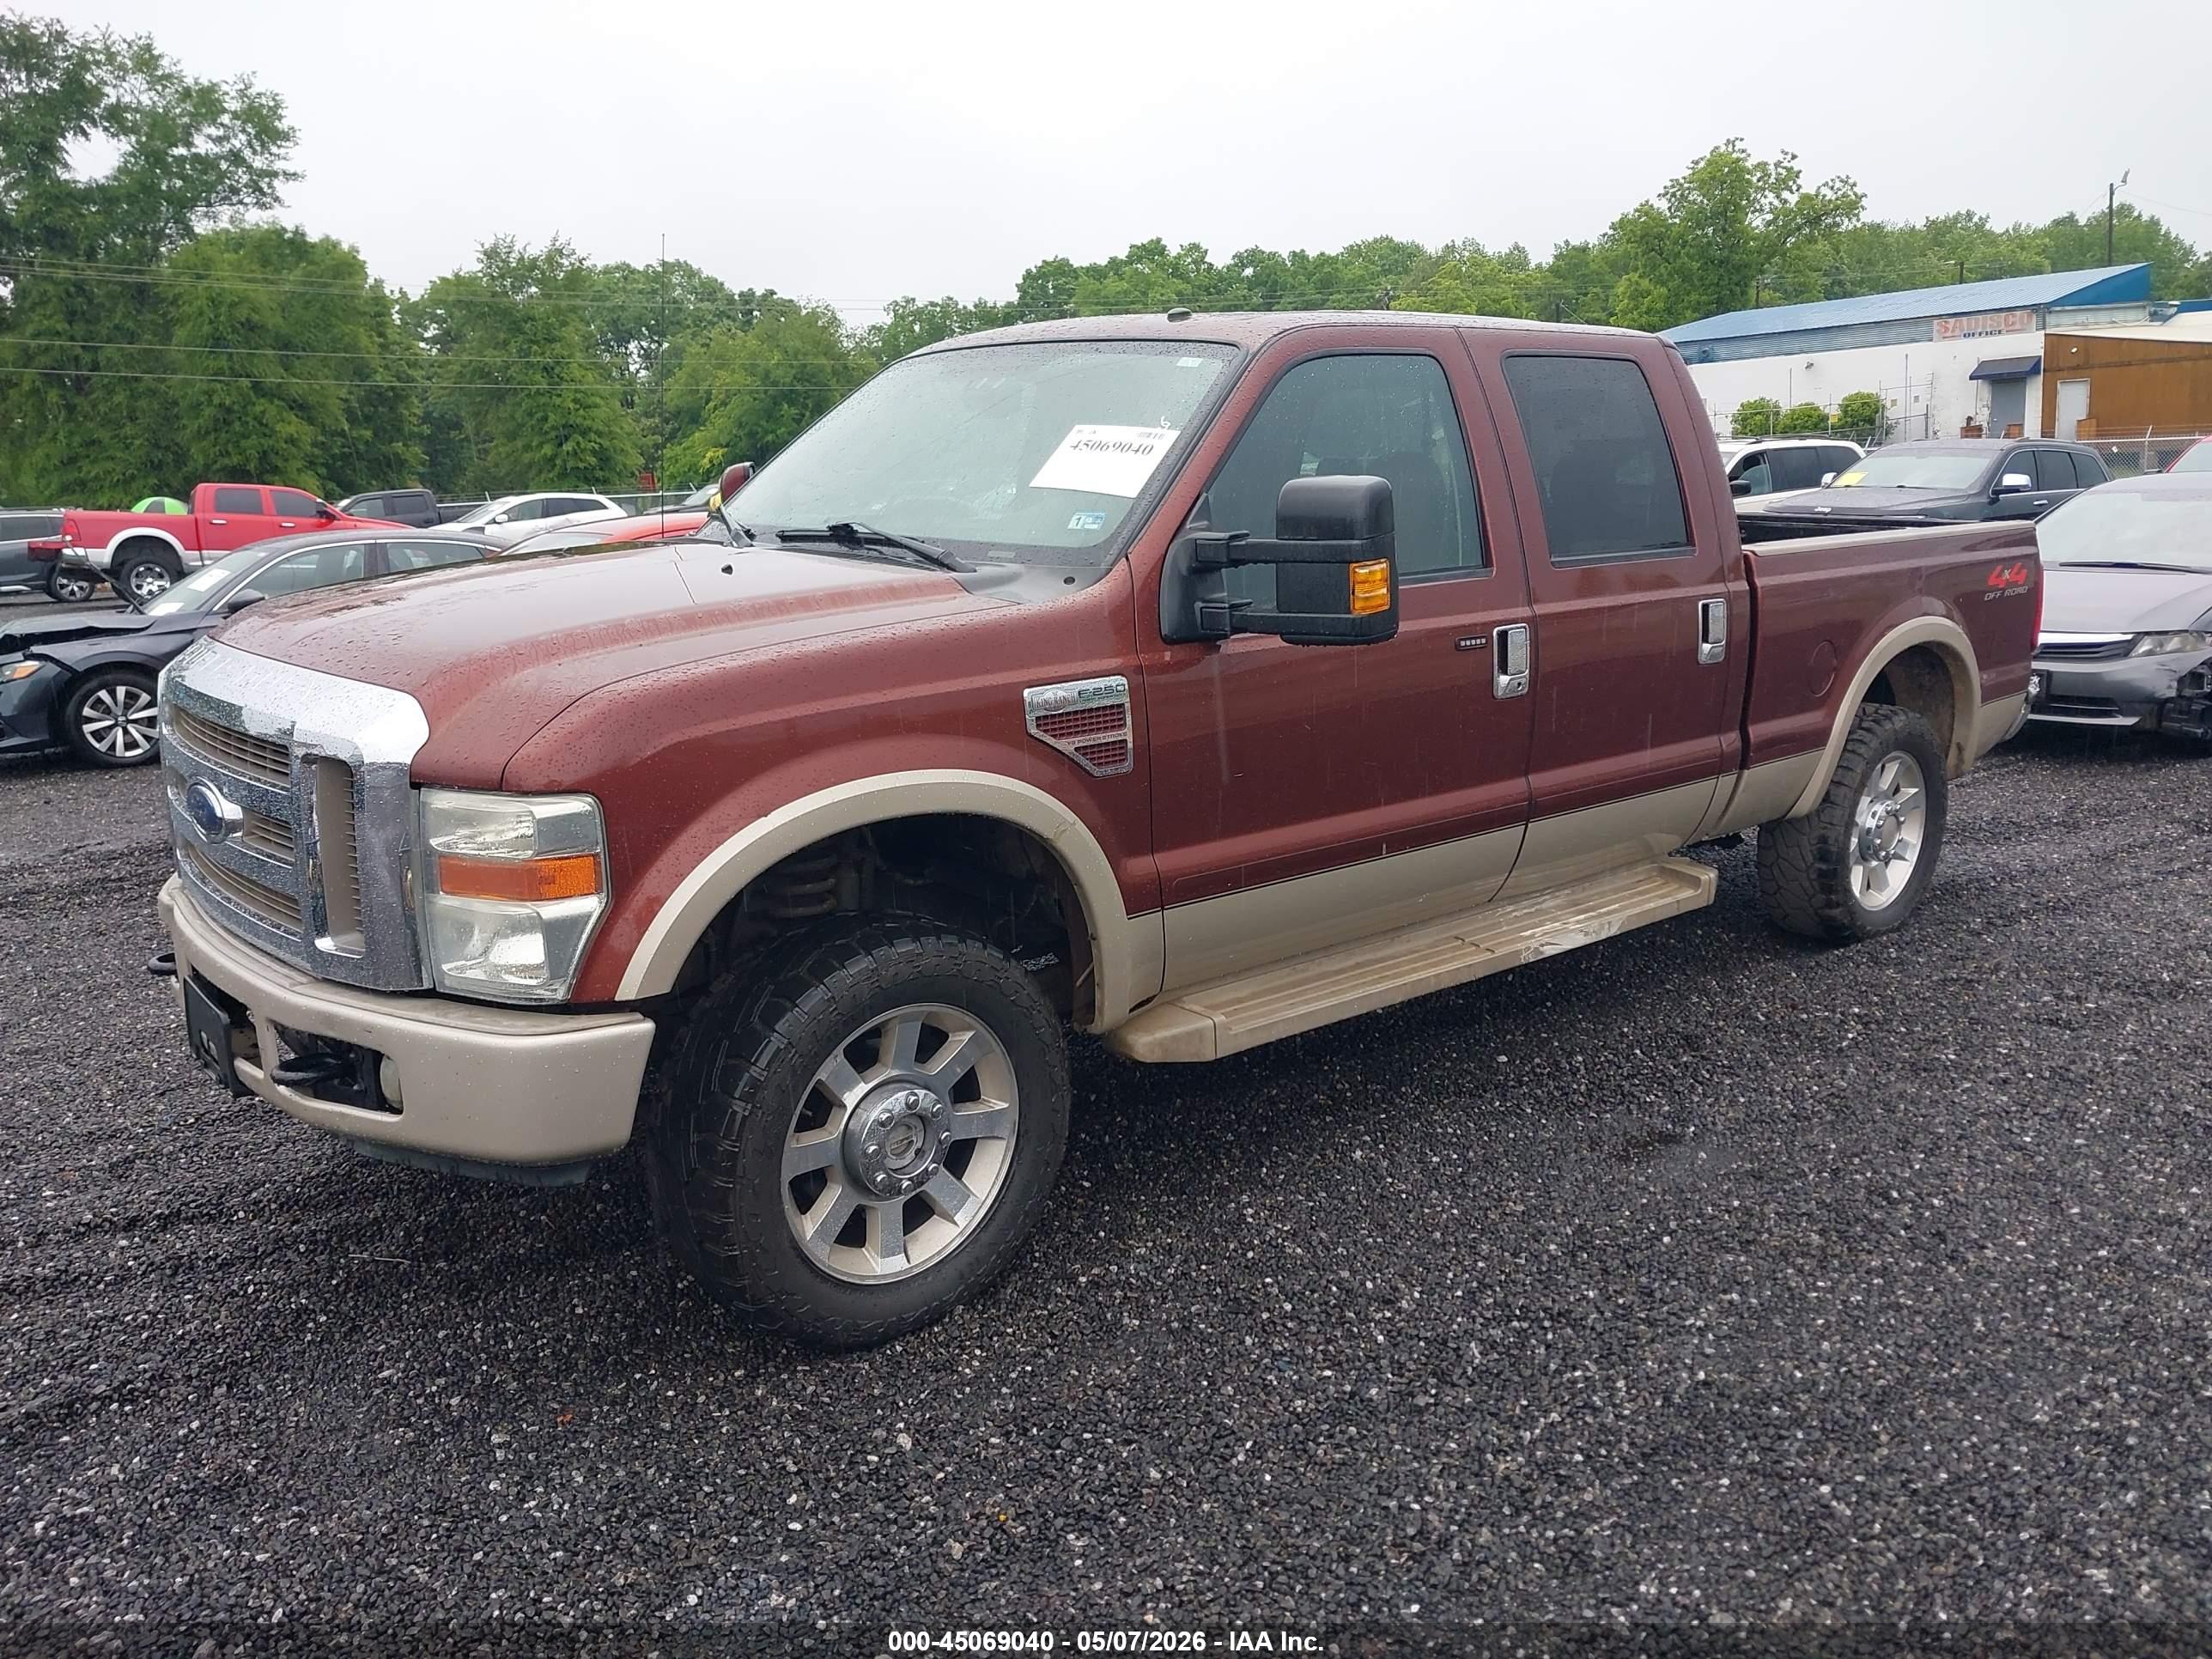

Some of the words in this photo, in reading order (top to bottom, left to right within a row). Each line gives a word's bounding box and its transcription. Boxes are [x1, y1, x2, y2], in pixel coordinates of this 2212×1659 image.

[1937, 312, 2033, 334] SADISCO
[1963, 329, 2004, 338] OFFICE
[1070, 440, 1154, 455] 45069040
[1984, 591, 2002, 601] OFF
[2004, 586, 2028, 597] ROAD
[1078, 684, 1126, 698] F-250
